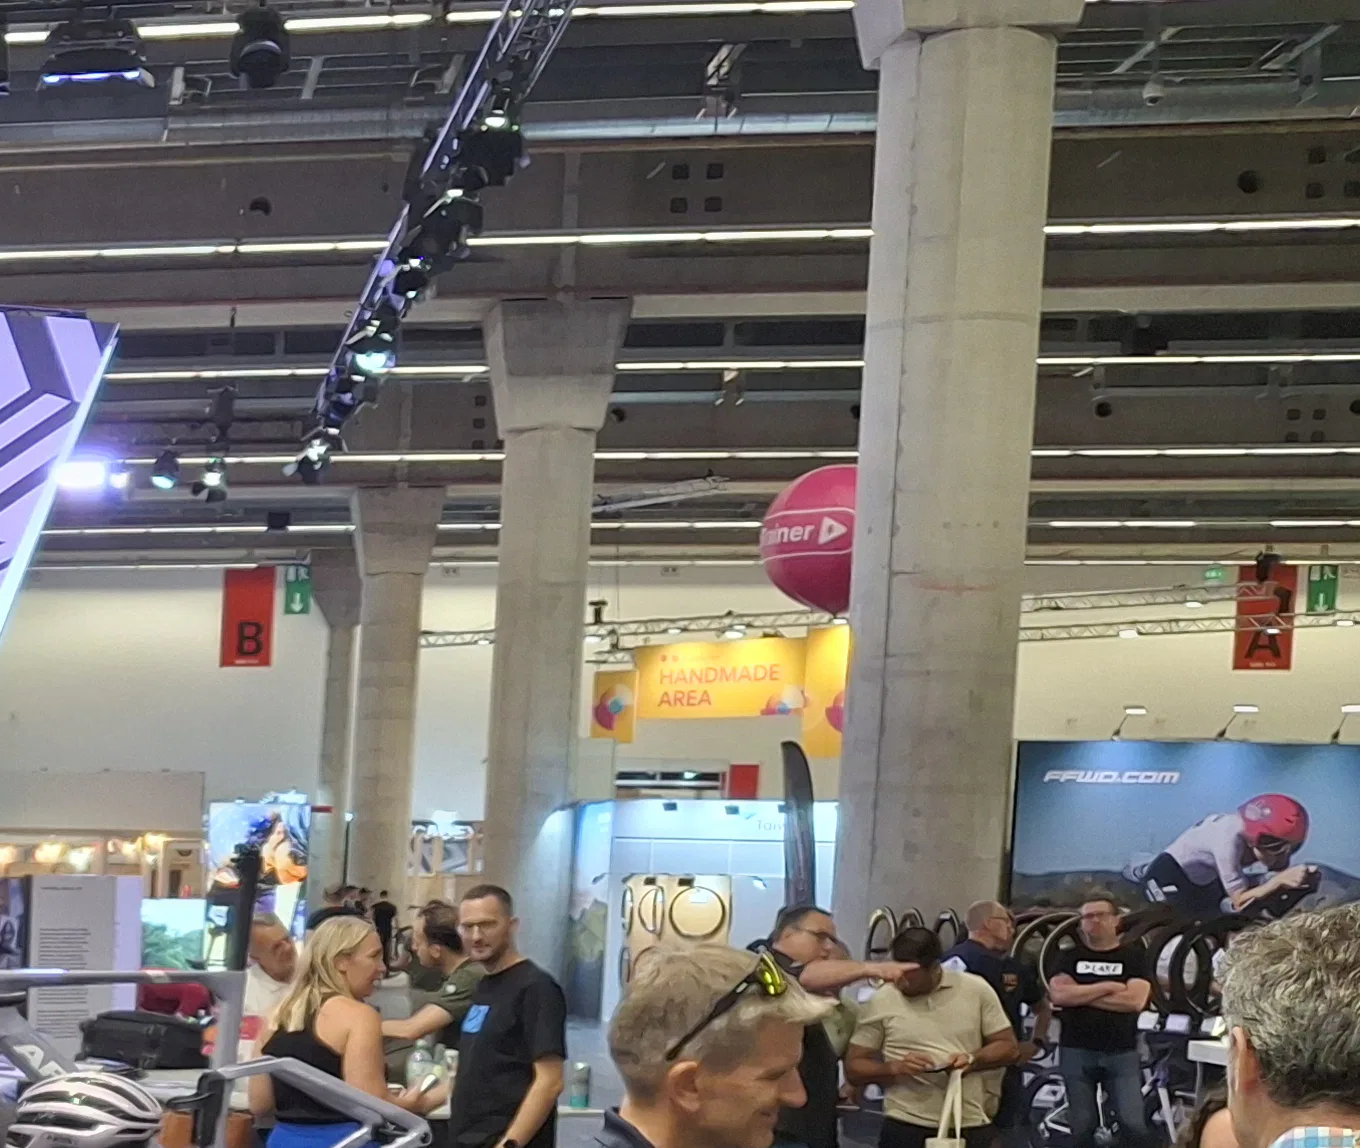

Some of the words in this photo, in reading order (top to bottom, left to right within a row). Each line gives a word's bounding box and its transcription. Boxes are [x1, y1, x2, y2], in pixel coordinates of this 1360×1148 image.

[237, 621, 264, 656] B
[1244, 622, 1282, 659] A
[659, 664, 781, 685] HANDMADE
[657, 689, 712, 707] AREA
